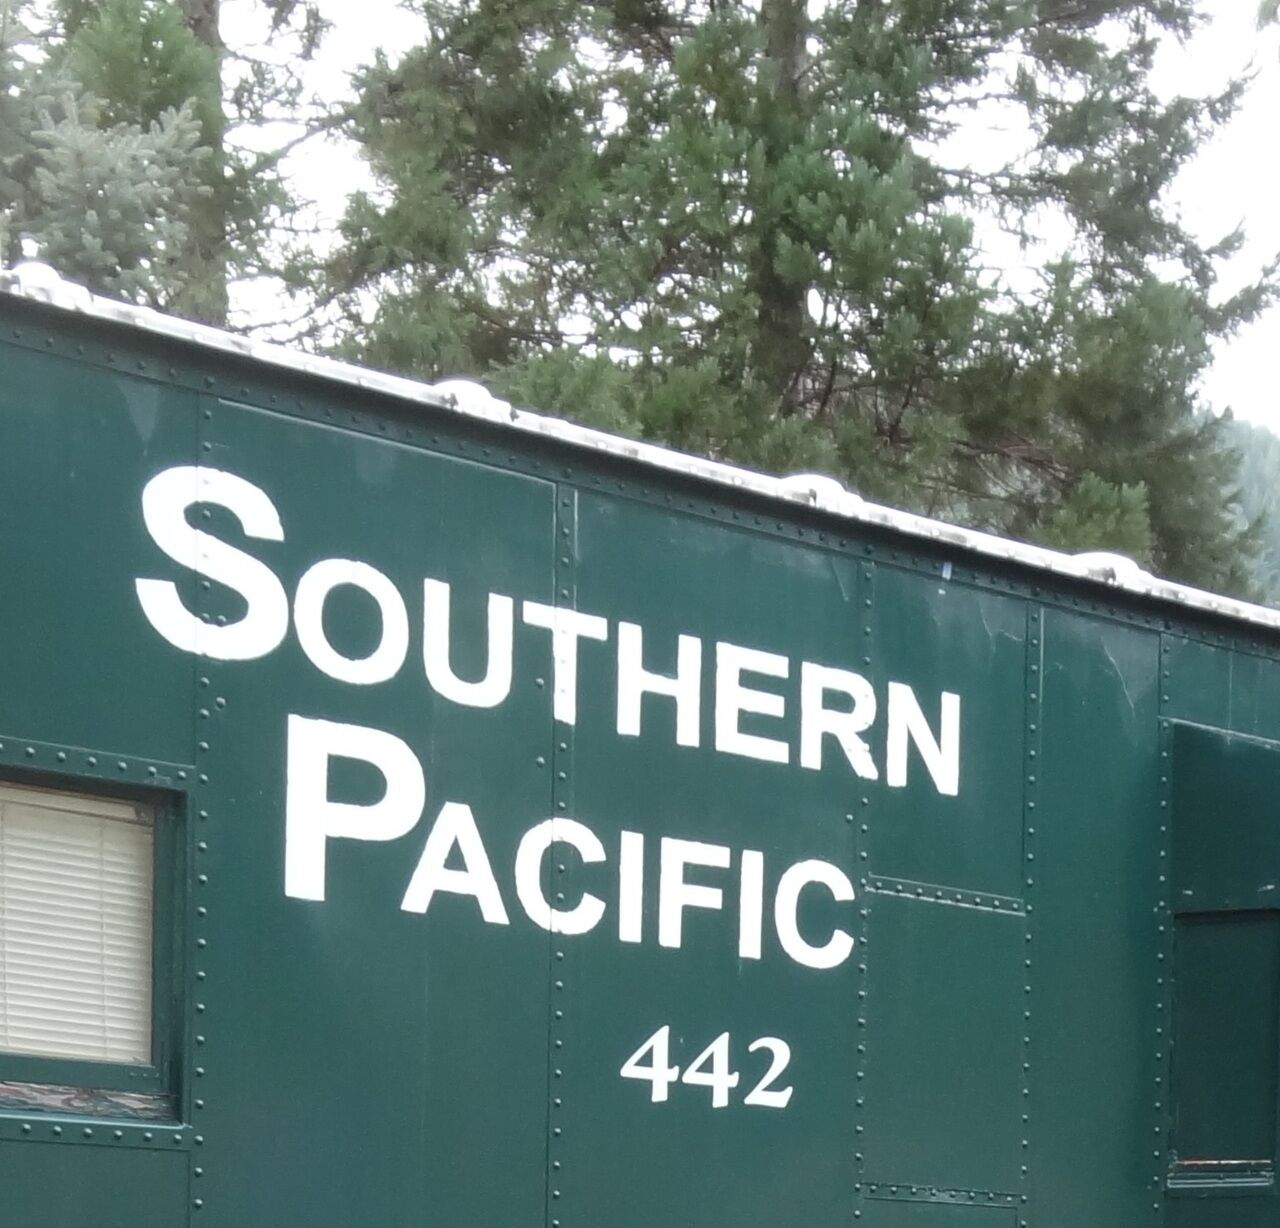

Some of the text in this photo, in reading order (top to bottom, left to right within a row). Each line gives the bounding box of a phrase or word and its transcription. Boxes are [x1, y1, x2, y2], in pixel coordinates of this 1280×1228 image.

[135, 465, 961, 797] SOUTHERN
[284, 713, 855, 970] PACIFIC
[620, 1025, 794, 1109] 442
